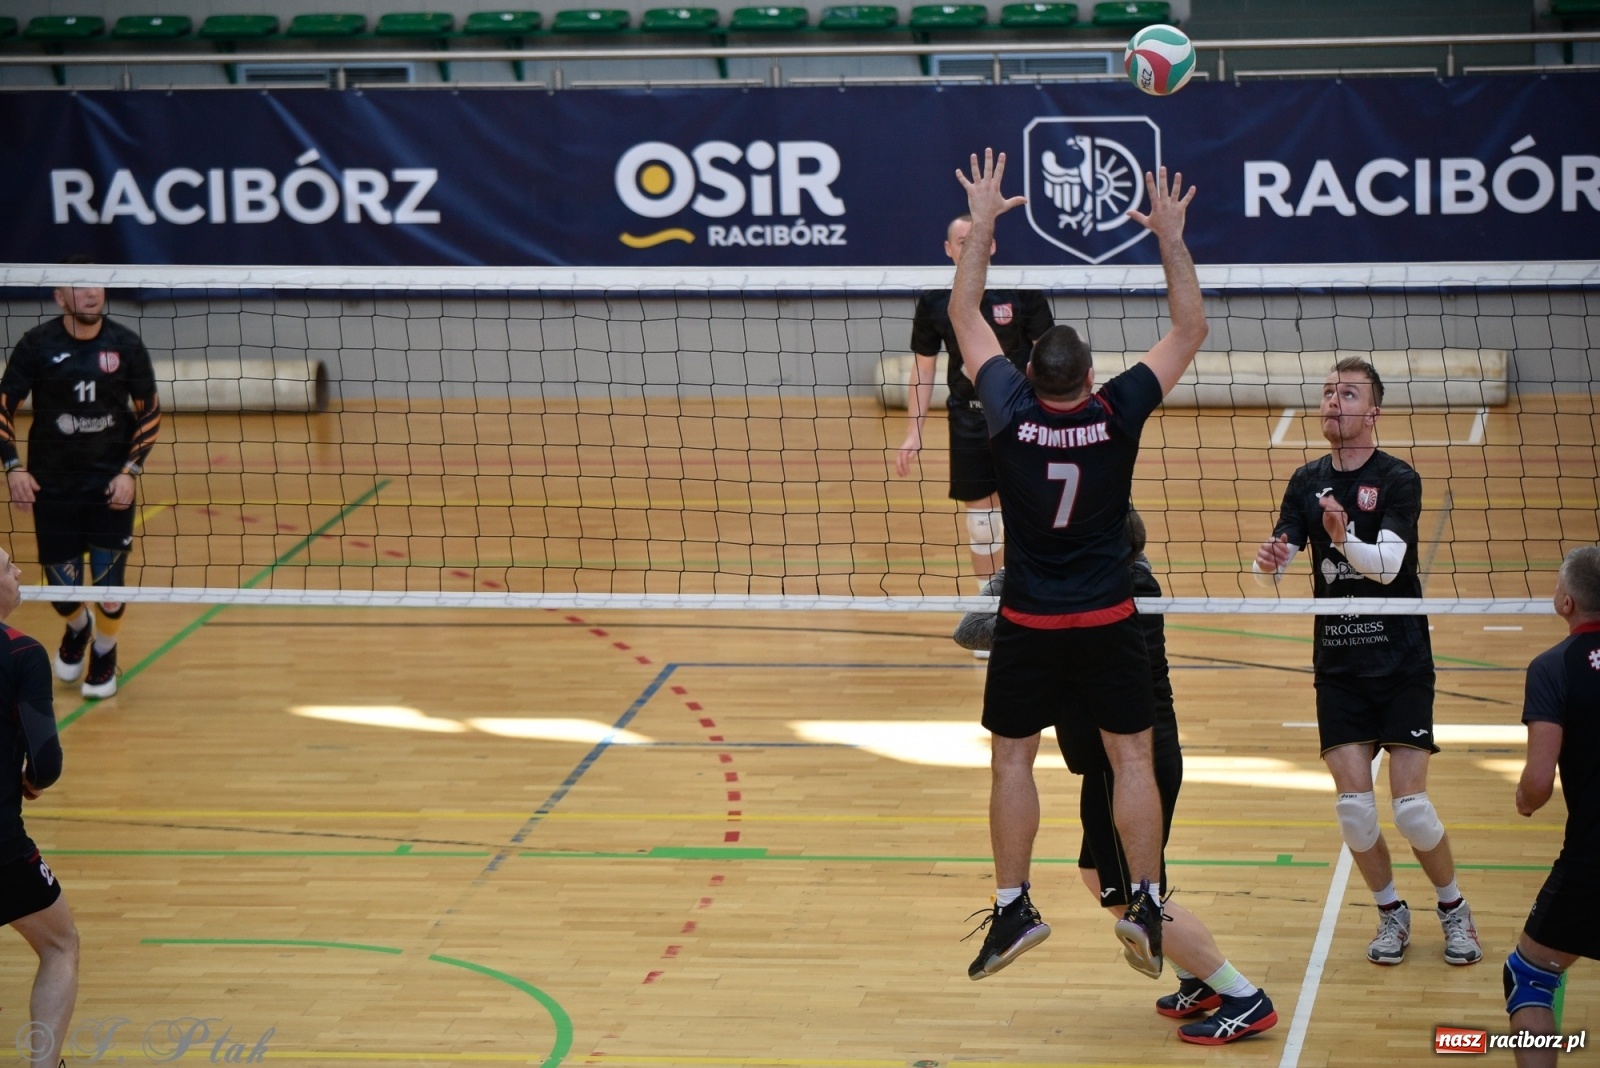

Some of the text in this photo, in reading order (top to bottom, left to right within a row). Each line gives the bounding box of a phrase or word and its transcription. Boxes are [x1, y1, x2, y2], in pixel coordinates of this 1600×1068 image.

[50, 147, 441, 225] RACIBÓRZ
[708, 218, 847, 246] RACIBÓRZ
[73, 380, 96, 402] 11
[1047, 463, 1079, 528] 7
[1325, 621, 1384, 635] PROGRESS
